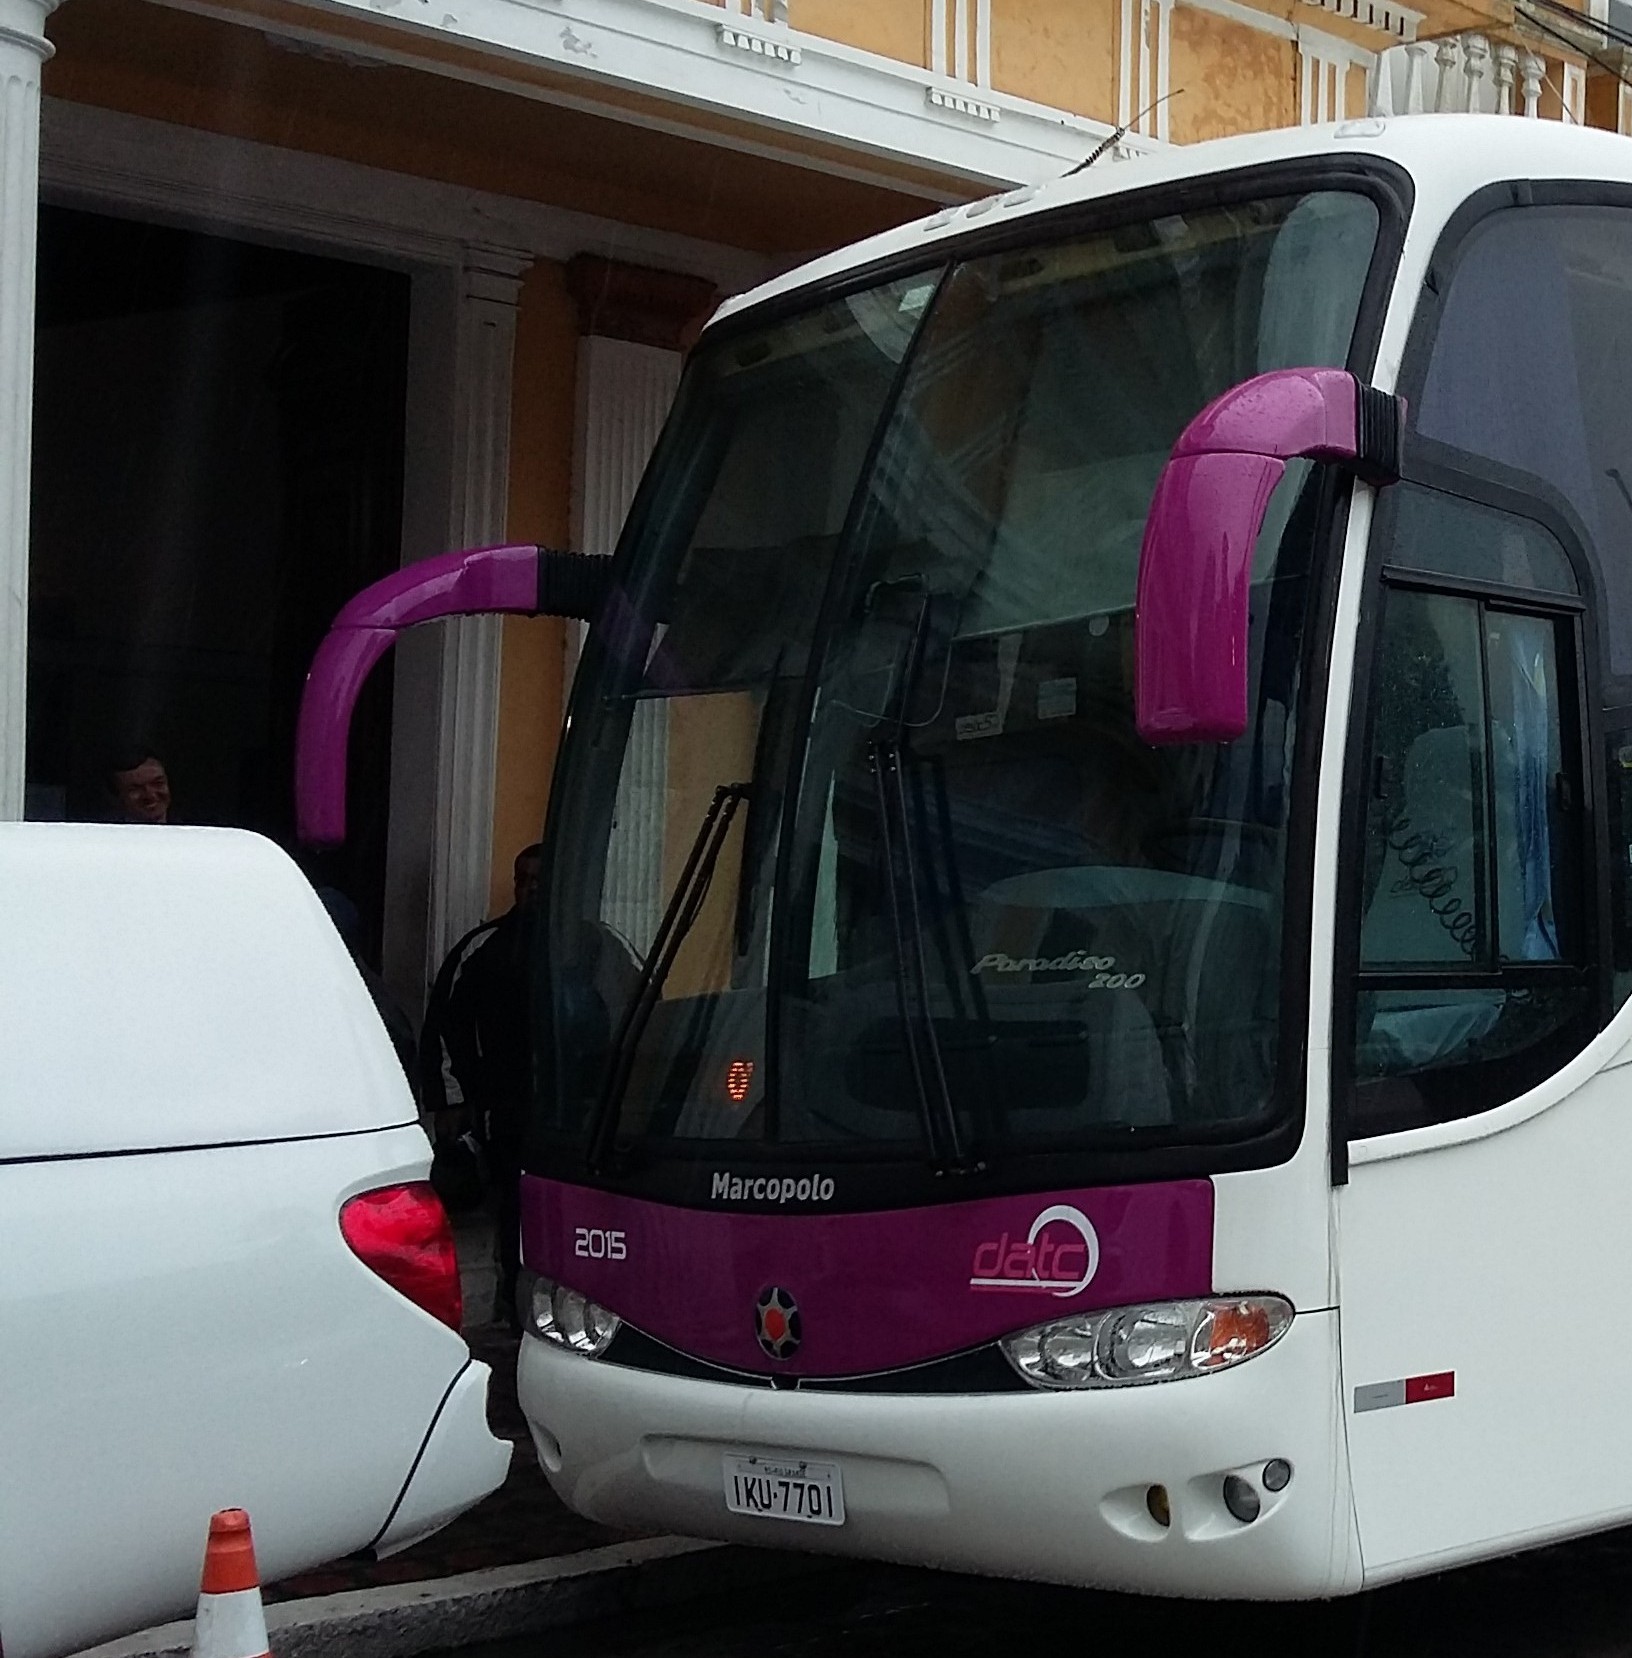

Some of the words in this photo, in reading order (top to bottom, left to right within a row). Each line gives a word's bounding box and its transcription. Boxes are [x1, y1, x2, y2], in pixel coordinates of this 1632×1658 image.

[969, 949, 1117, 975] Paradiso
[1087, 972, 1147, 990] 200
[710, 1171, 836, 1205] Marcopolo
[574, 1226, 628, 1261] 2015
[972, 1231, 1087, 1280] datc
